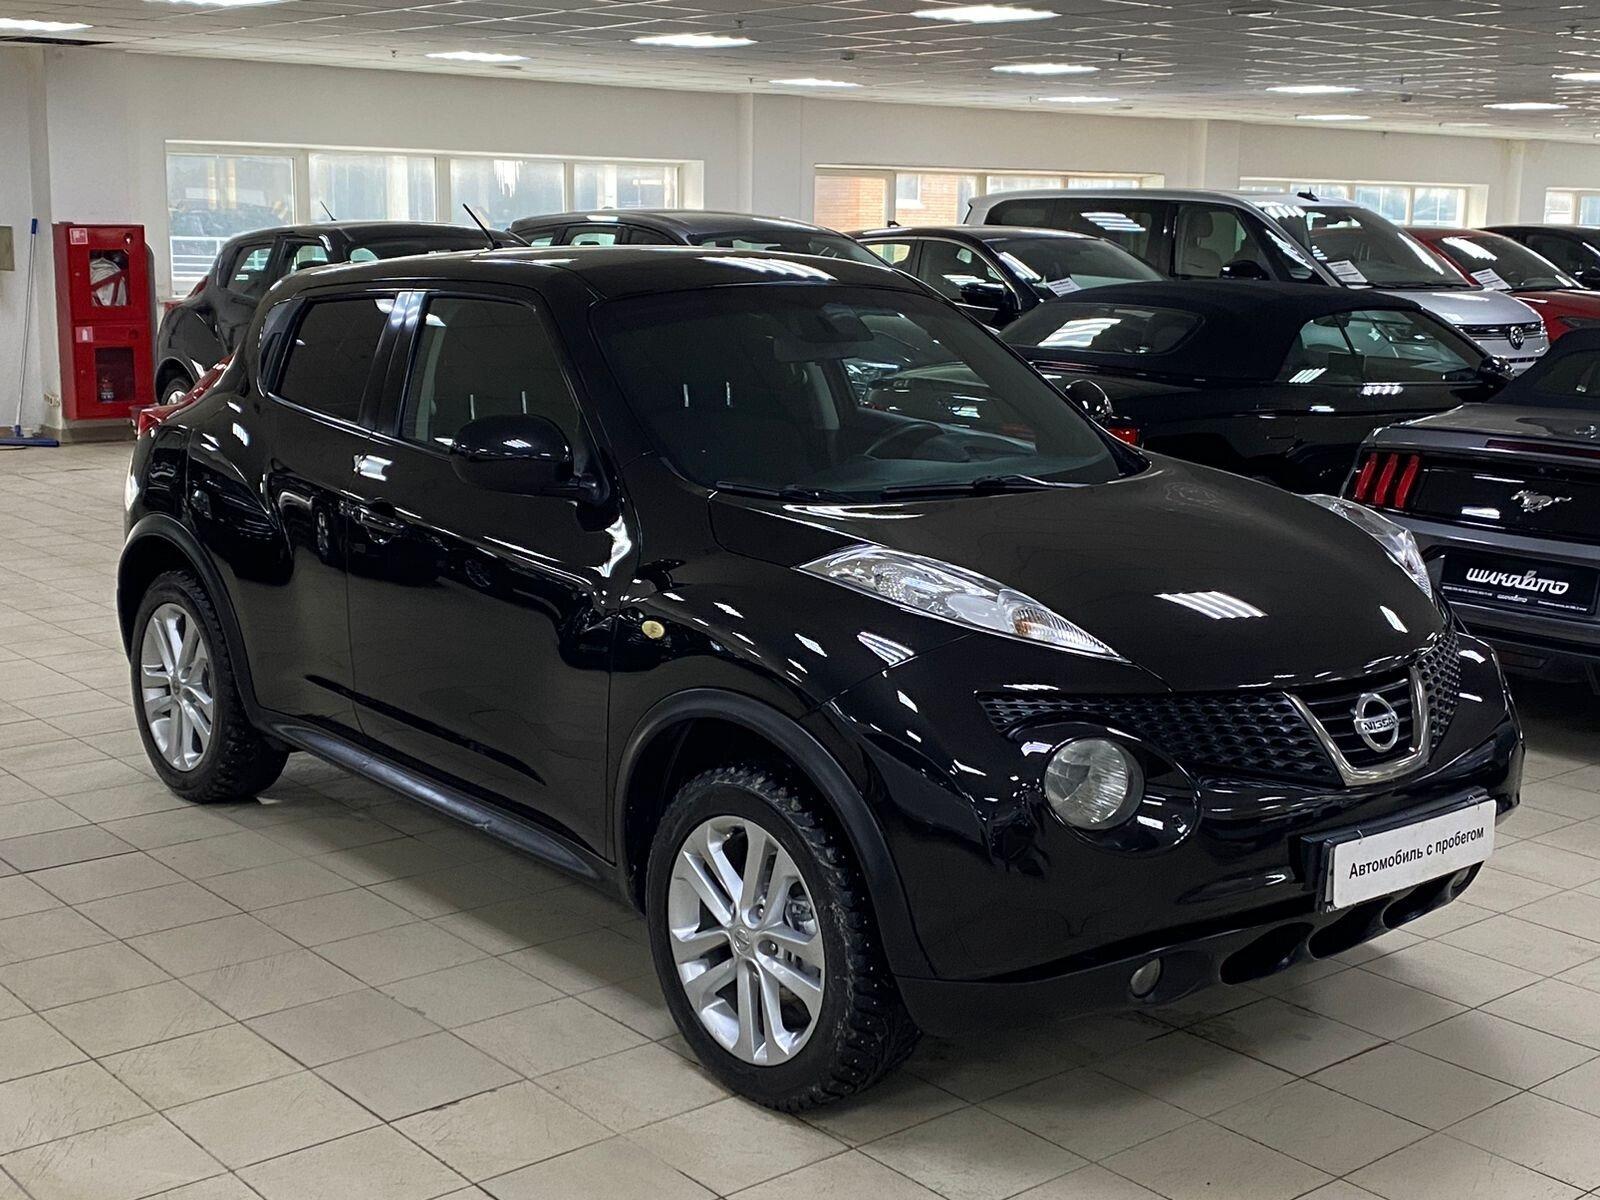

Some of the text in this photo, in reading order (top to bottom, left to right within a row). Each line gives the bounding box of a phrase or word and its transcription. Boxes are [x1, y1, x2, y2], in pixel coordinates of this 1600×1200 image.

[1349, 827, 1484, 879] Автомобиль с пробегом
